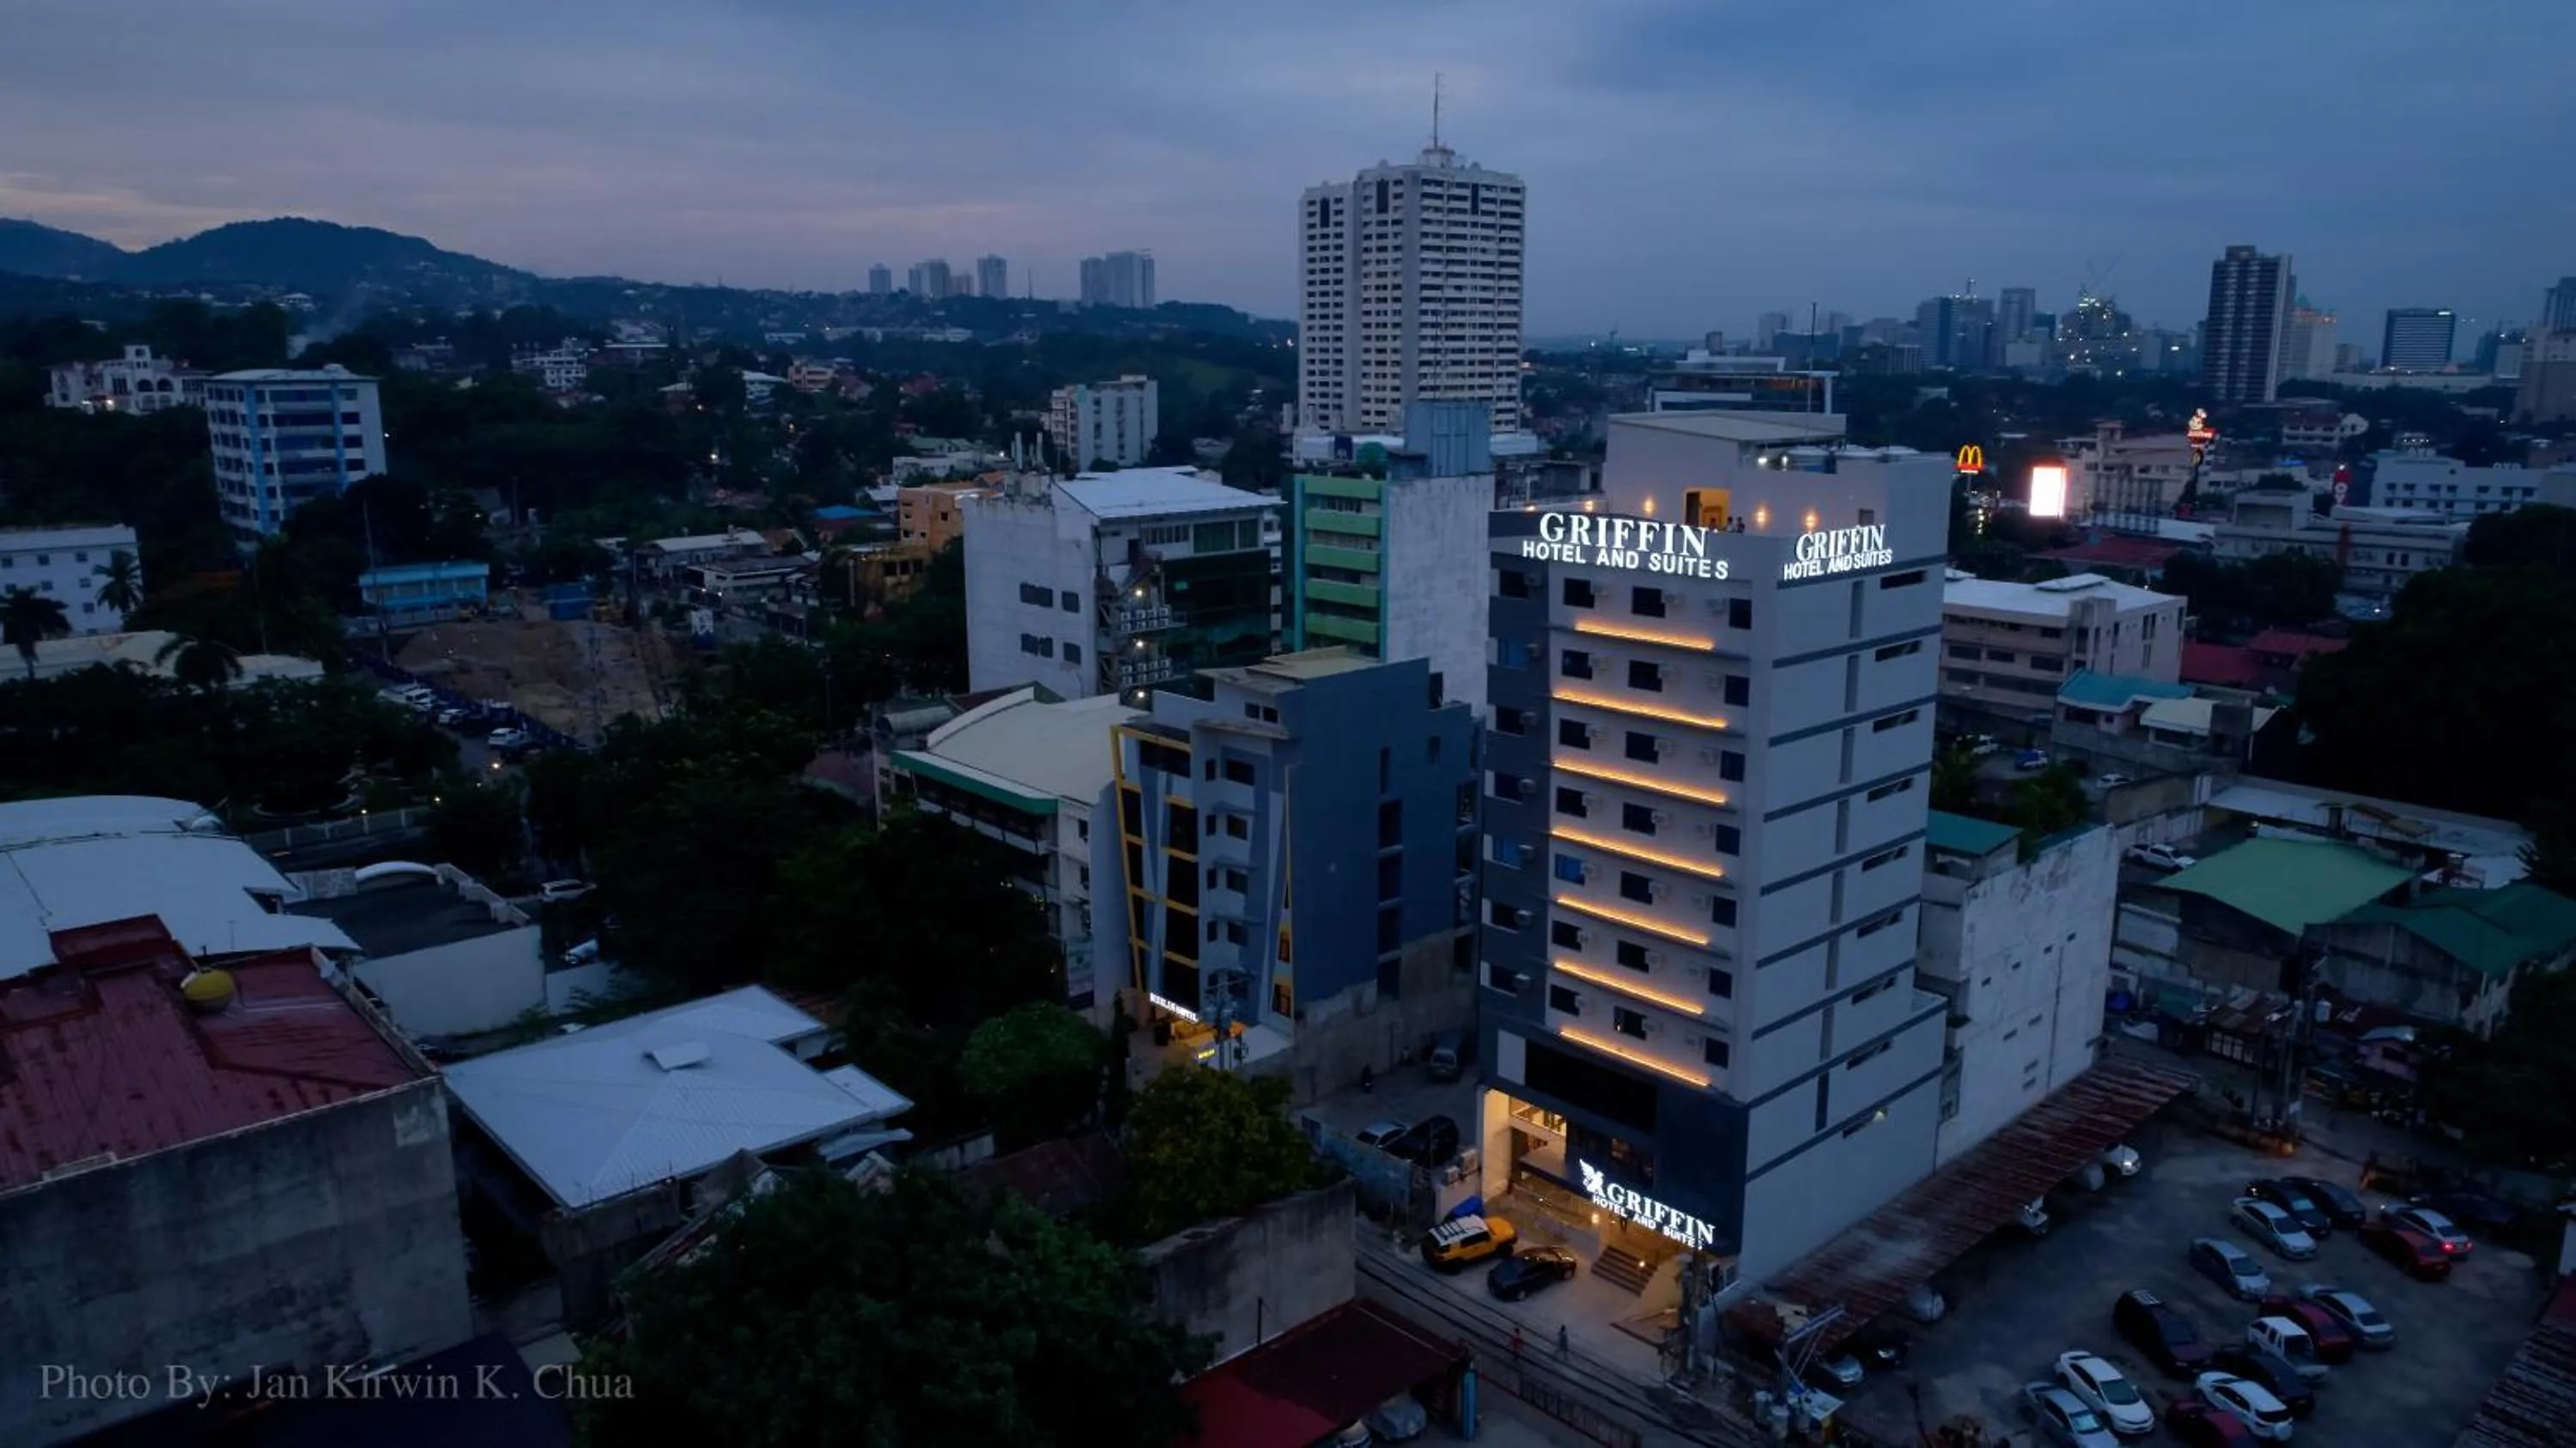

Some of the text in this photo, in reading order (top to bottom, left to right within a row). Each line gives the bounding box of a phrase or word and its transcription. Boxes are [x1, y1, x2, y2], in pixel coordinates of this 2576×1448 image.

[1540, 513, 1710, 557] GRIFFIN
[1795, 524, 1886, 561] GRIFFIN
[1522, 540, 1728, 581] HOTEL AND SUITES
[1783, 549, 1893, 581] HOTEL AND SUITES
[1592, 1193, 1627, 1218] HOTEL
[1632, 1214, 1656, 1230] AND
[1607, 1183, 1716, 1244] GRIFFIN
